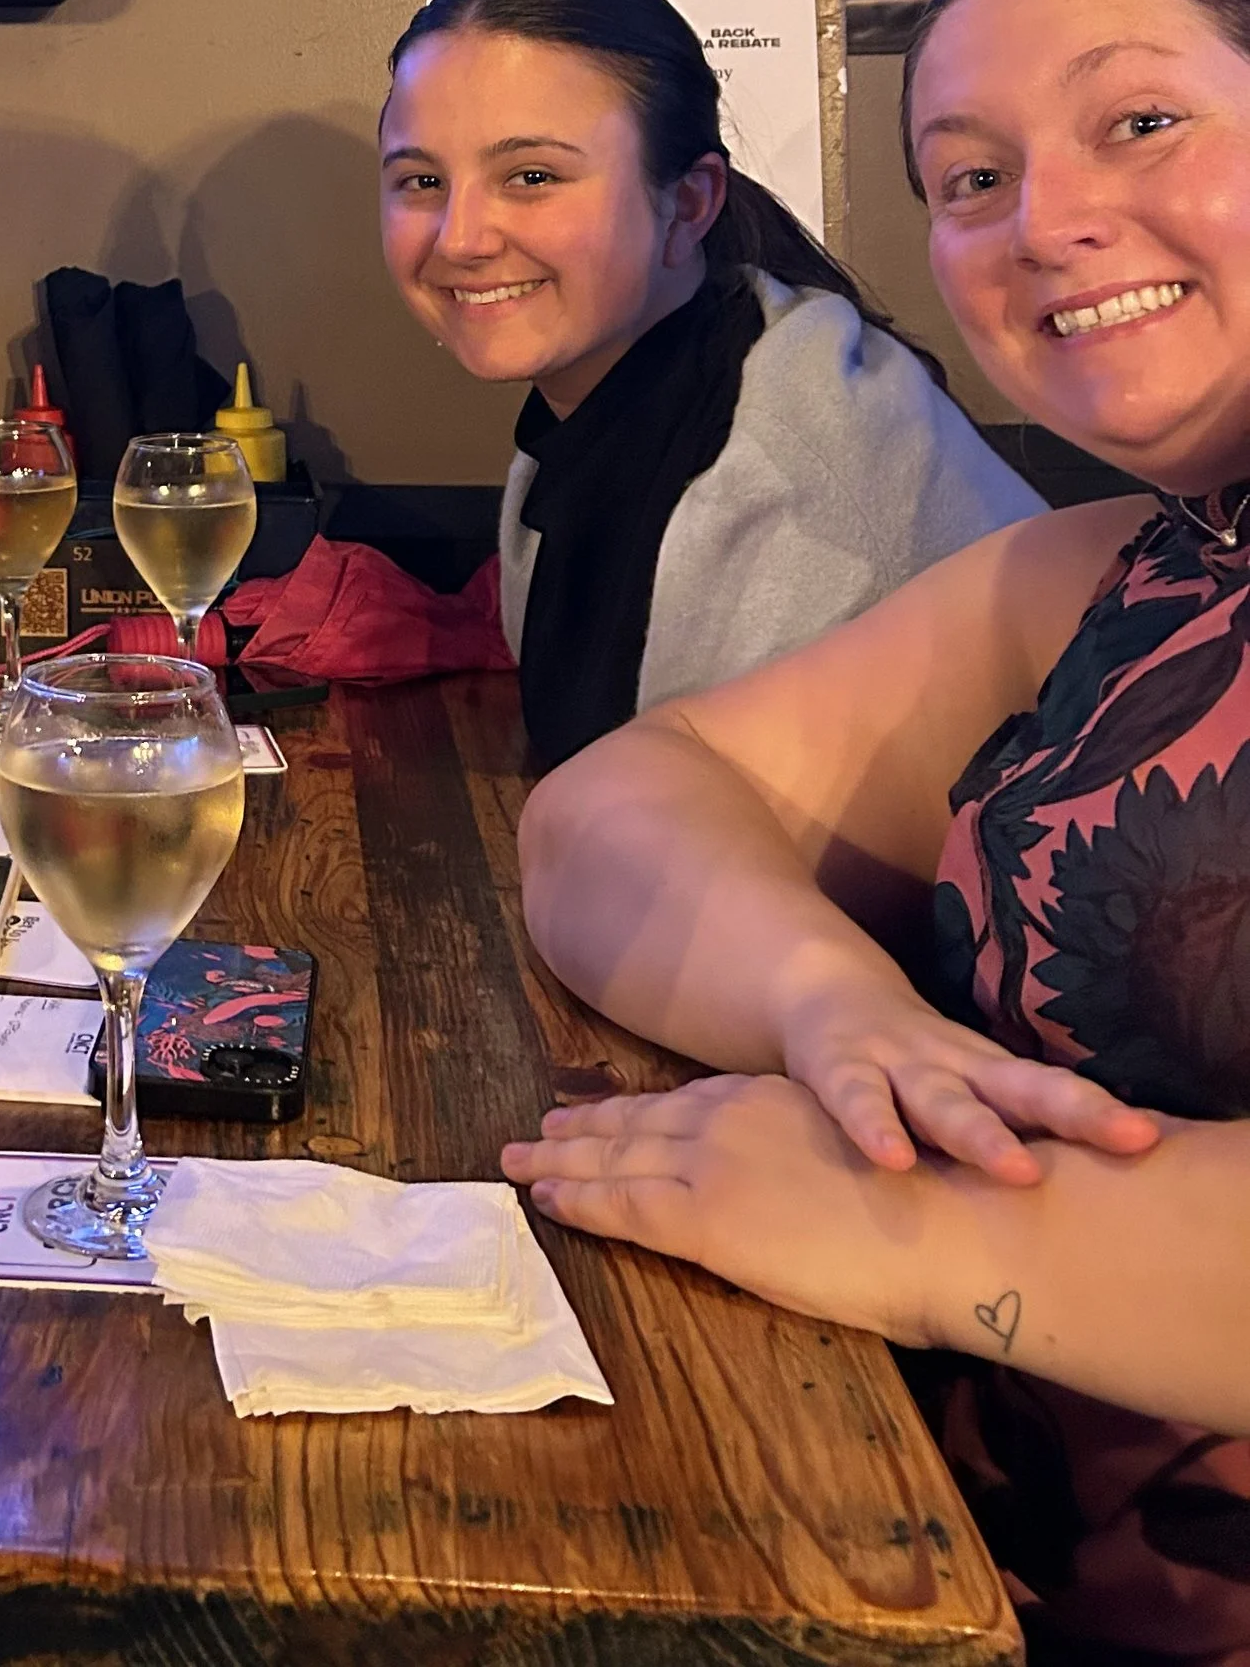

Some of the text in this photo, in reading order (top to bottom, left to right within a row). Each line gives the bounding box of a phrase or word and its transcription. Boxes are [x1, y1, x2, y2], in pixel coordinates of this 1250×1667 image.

[710, 28, 755, 38] BACK
[718, 37, 781, 49] REBATE
[81, 588, 161, 605] UNION PU
